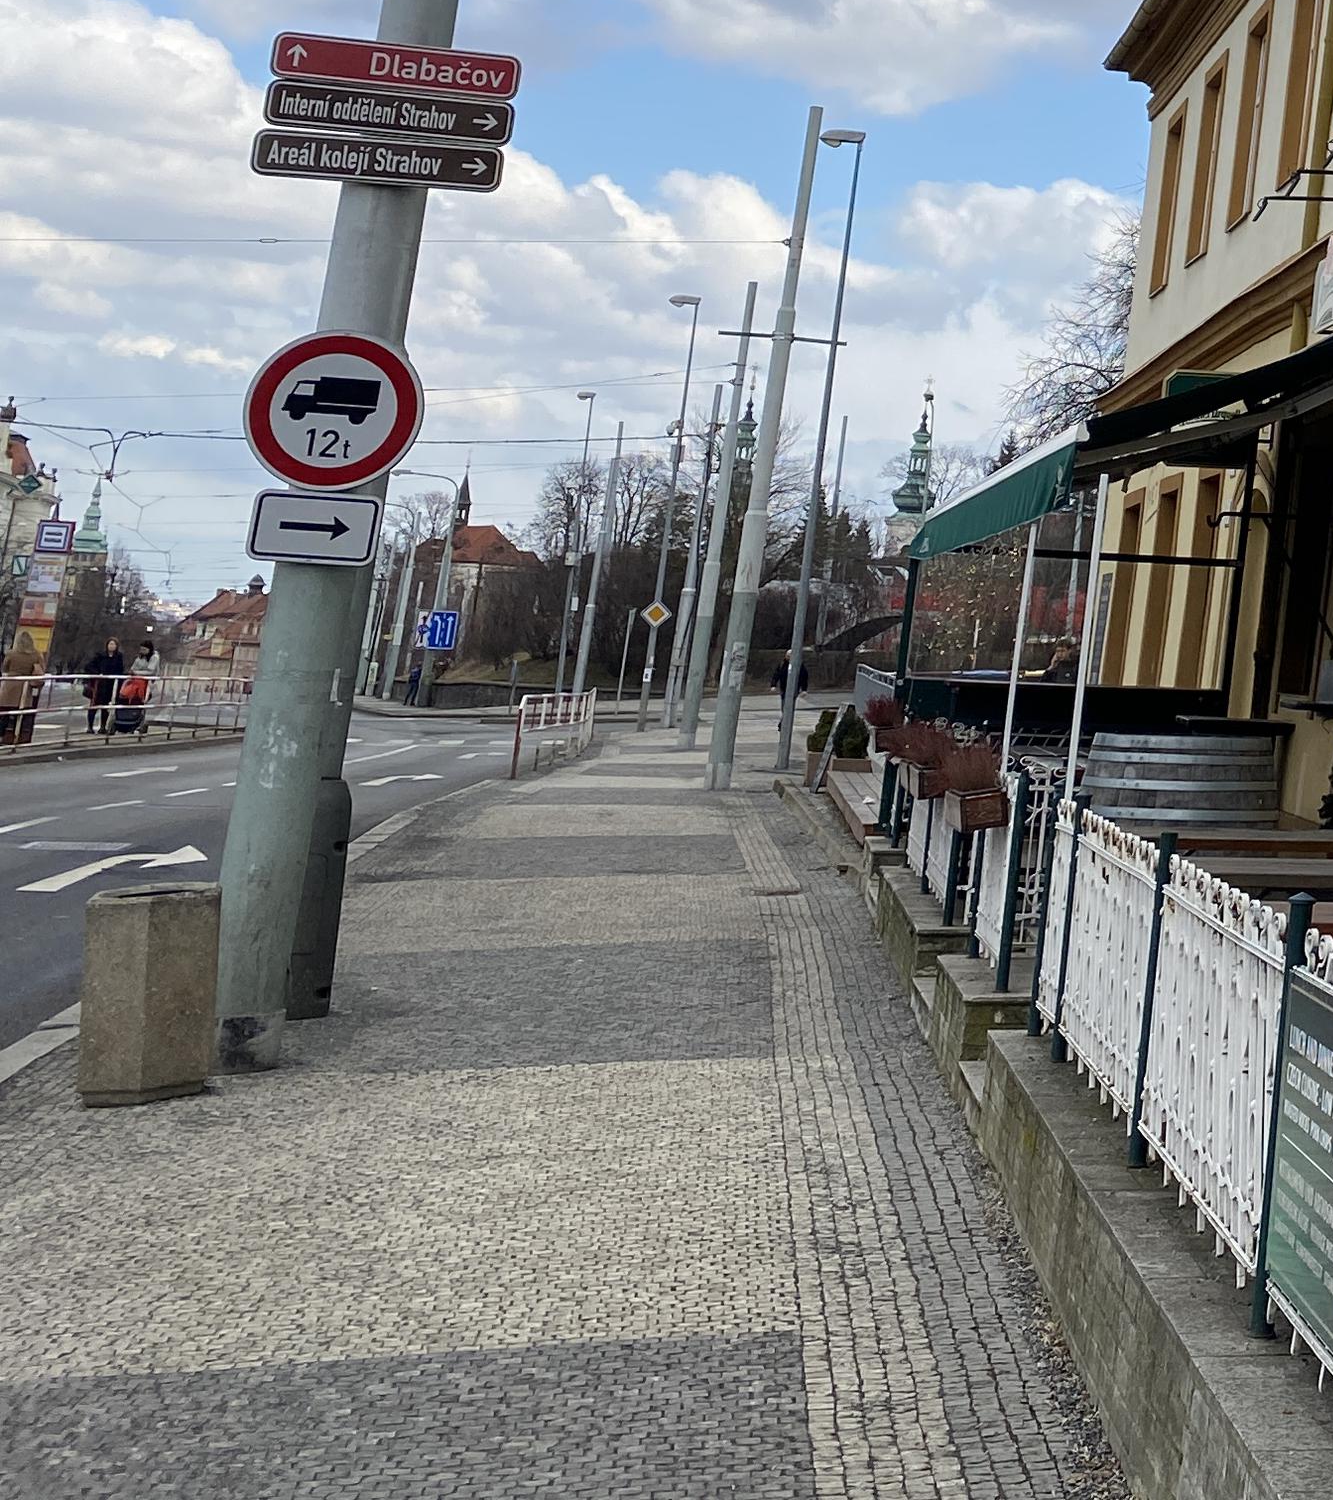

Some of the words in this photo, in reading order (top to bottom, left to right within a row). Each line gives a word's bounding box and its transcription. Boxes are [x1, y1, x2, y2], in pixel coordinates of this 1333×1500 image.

[368, 51, 506, 90] Dlabačov
[279, 90, 330, 116] Interní
[332, 99, 398, 125] oddělení
[399, 105, 457, 131] Strahov
[266, 140, 316, 167] Areál
[319, 143, 372, 175] kolejí
[373, 148, 443, 176] Strahov
